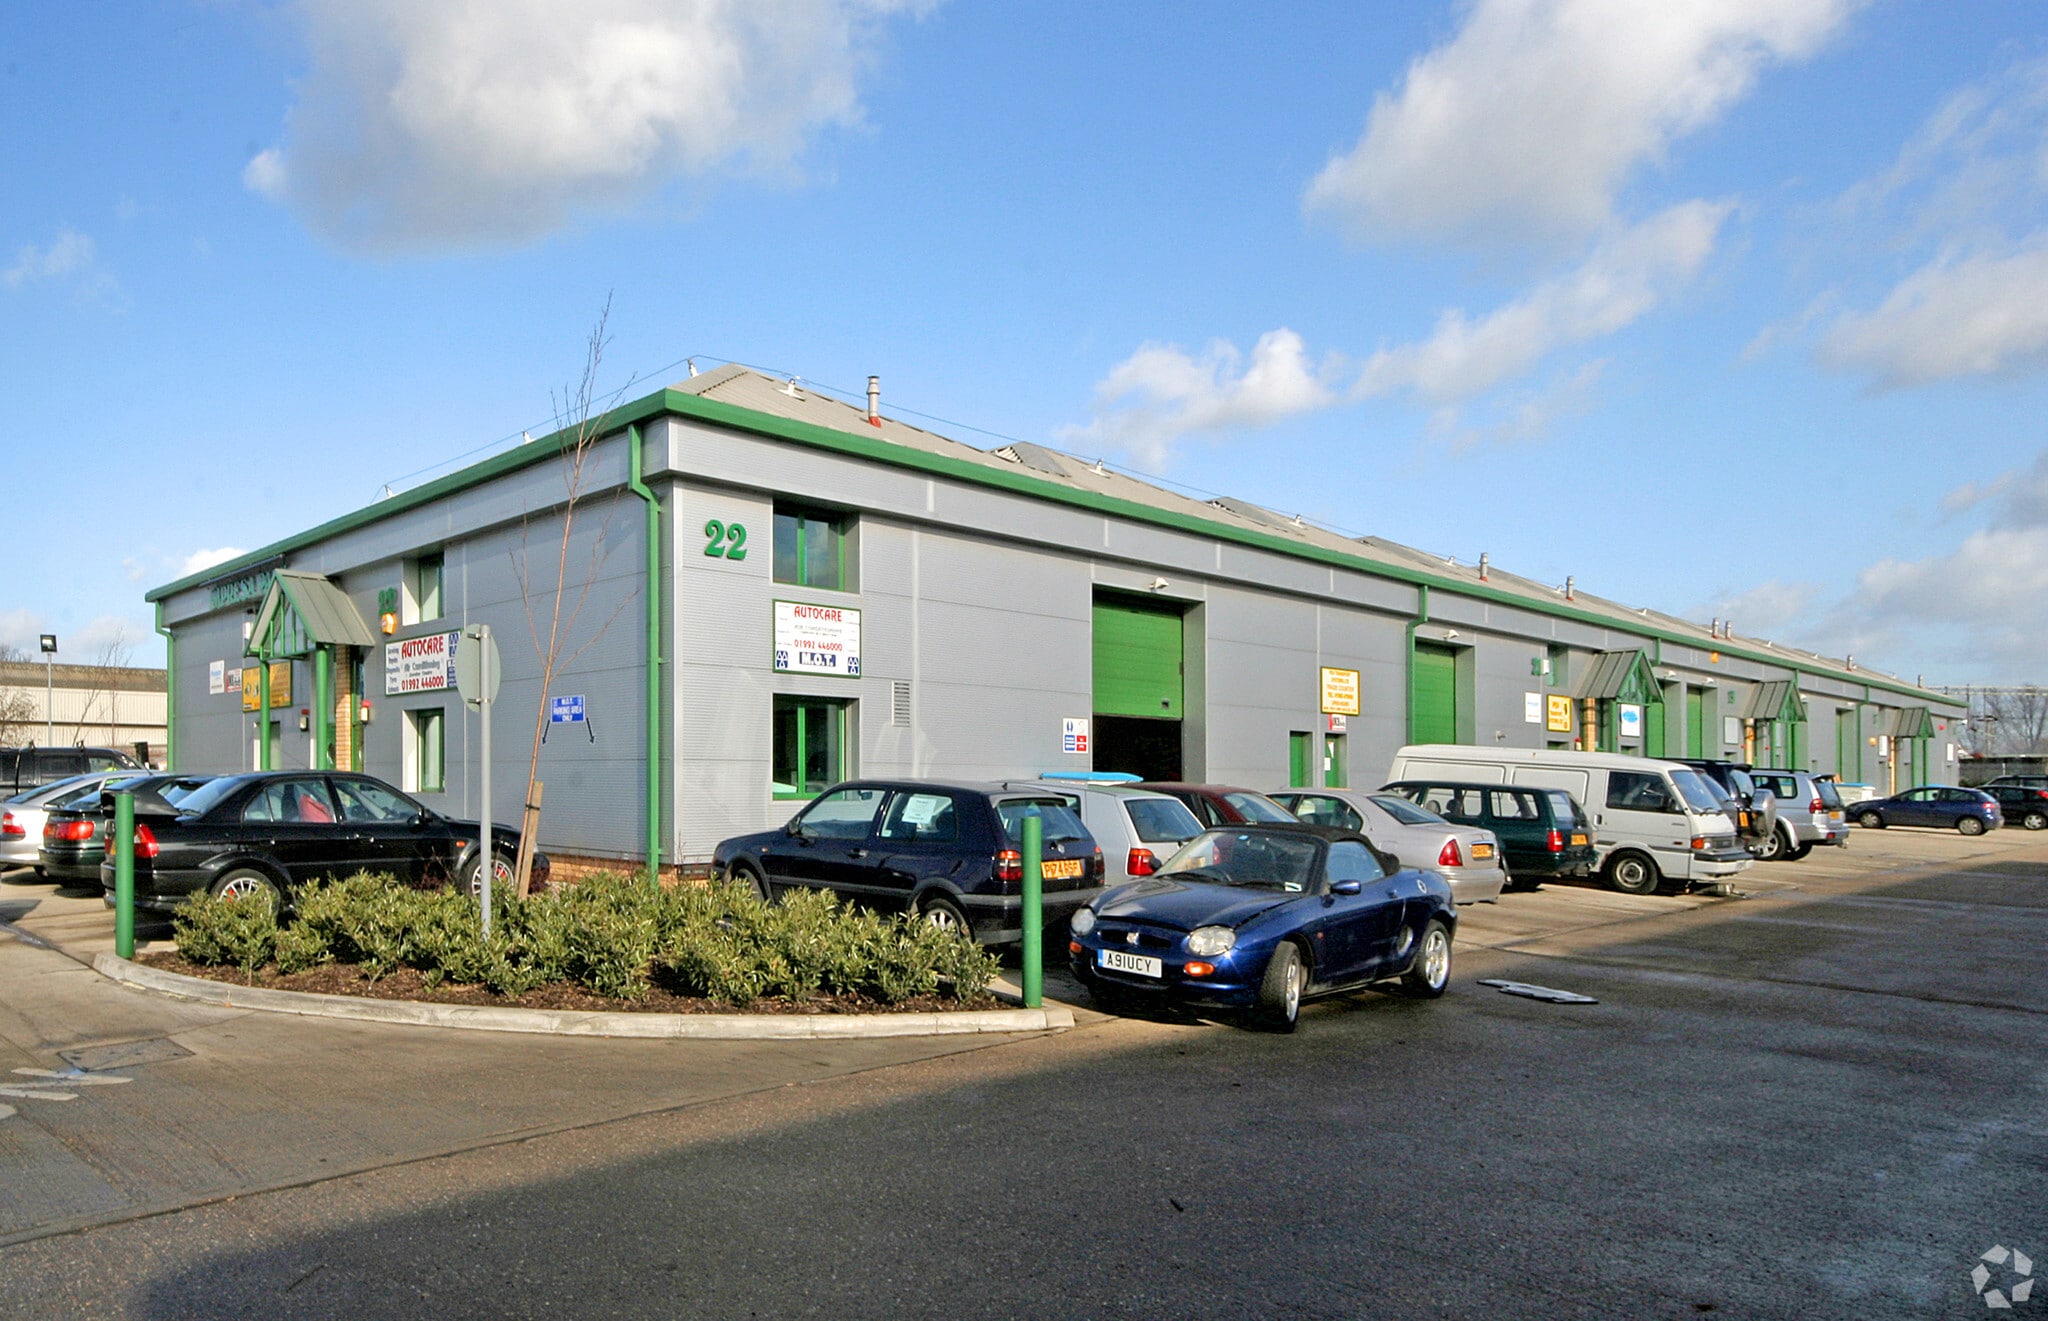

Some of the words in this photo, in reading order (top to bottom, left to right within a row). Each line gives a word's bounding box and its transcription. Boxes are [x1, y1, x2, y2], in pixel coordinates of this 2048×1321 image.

[704, 519, 747, 561] 22
[794, 606, 842, 622] AUTOCARE
[402, 636, 444, 659] AUTOCARE
[794, 640, 815, 649] 01992
[818, 641, 843, 651] 446000
[801, 653, 834, 667] M.O.T.
[401, 679, 419, 691] 01992
[421, 676, 444, 688] 446000
